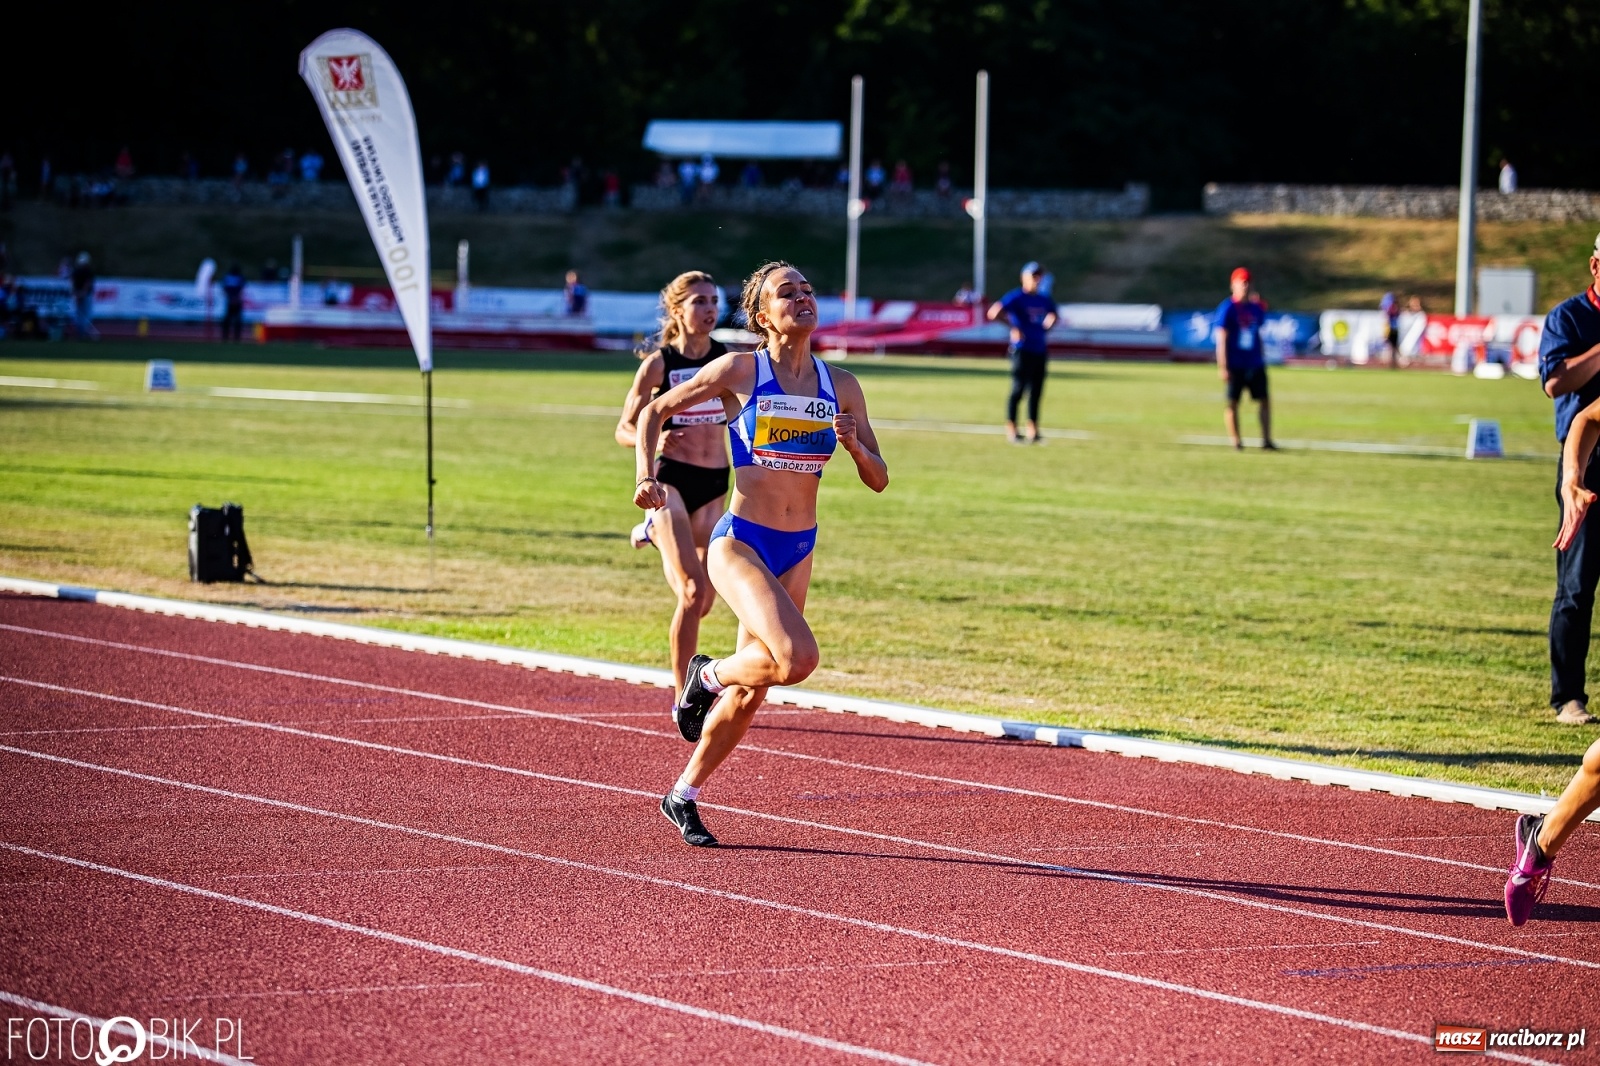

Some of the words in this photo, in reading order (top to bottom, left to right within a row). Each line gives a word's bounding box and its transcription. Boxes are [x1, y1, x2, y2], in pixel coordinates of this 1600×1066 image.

[773, 404, 798, 412] Racibórz
[805, 401, 833, 419] 484
[769, 428, 827, 446] KORBUT
[761, 459, 804, 472] RACIBÓRZ
[805, 463, 822, 472] 2019
